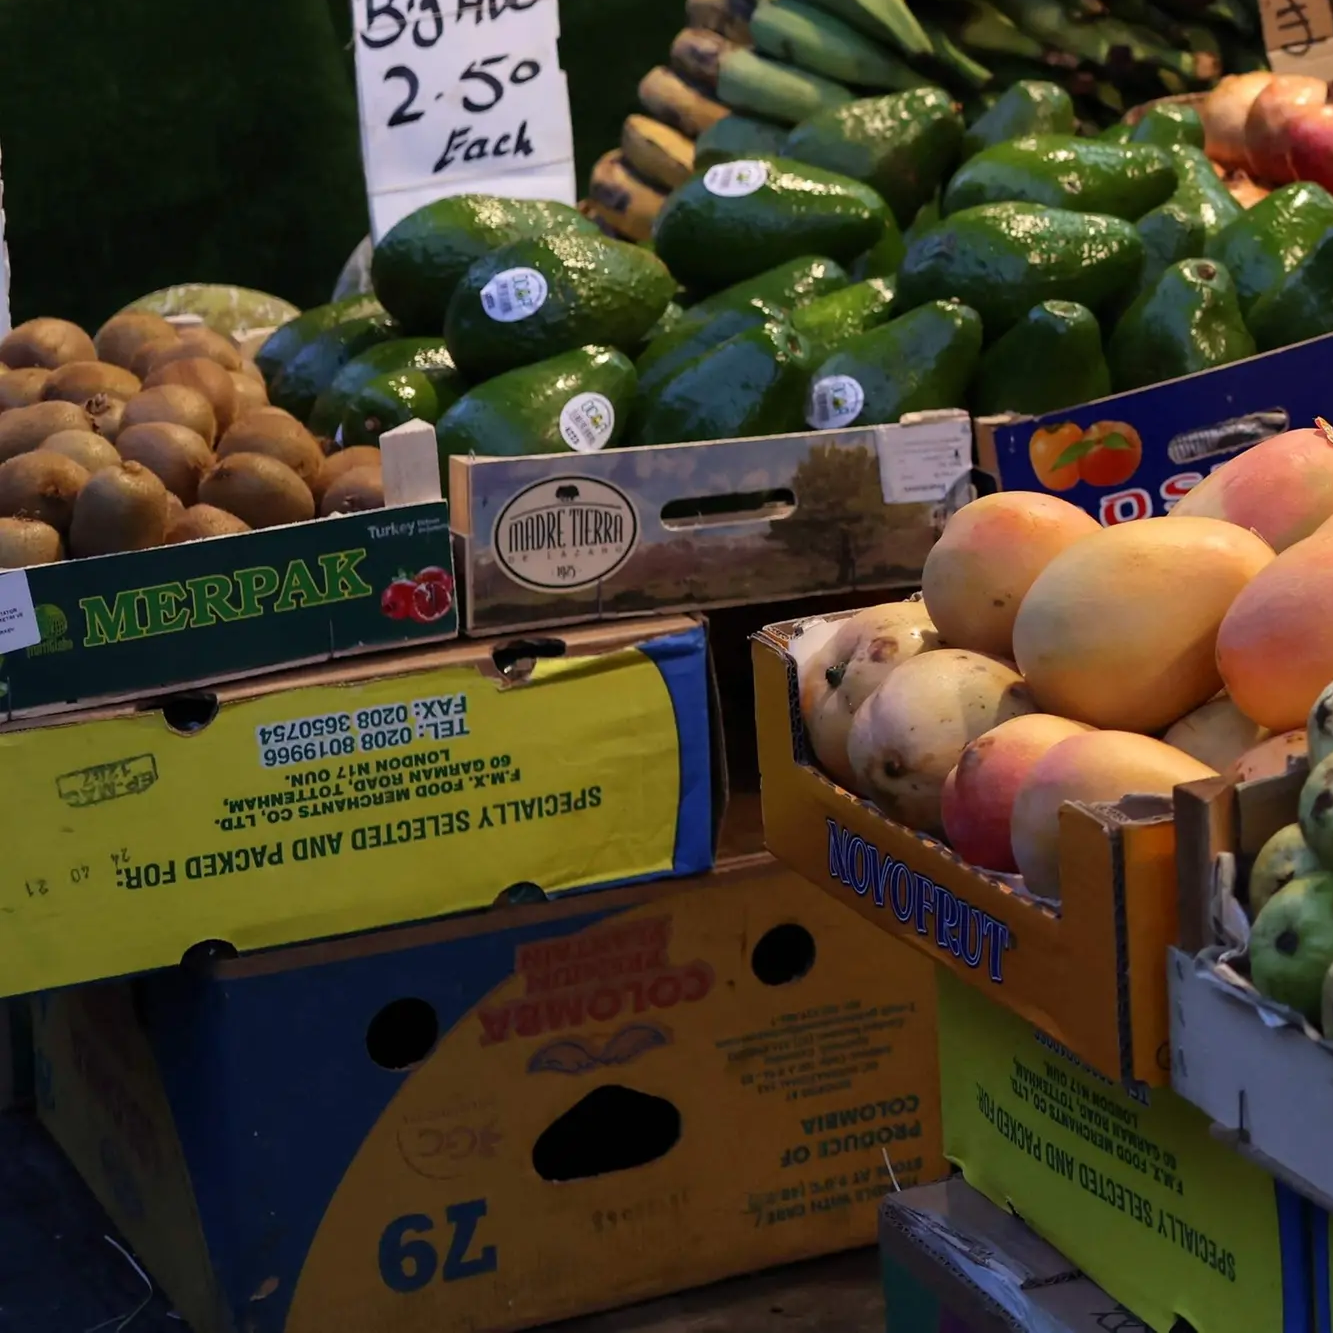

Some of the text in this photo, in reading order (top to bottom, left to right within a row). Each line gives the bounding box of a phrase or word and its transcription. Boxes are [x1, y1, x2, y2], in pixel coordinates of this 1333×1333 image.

[432, 120, 534, 174] Each
[367, 520, 415, 539] Turkey
[508, 507, 624, 554] MADRE TIERRA
[80, 548, 373, 648] MERPAK
[259, 695, 468, 746] FAX: 0208 3650754
[264, 717, 470, 767] TEL: 0208 8019966
[223, 754, 512, 814] 60 GARMAN ROAD, TOTTENHAM,
[336, 761, 372, 781] N17
[375, 748, 450, 773] LONDON
[469, 767, 521, 789] F.M.X.
[298, 784, 410, 819] MERCHANTS
[417, 778, 464, 798] FOOD
[115, 785, 602, 889] SPECIALLY SELECTED AND PACKED FOR:
[214, 813, 256, 831] LTD.
[825, 817, 1009, 984] NOVOFRUT
[800, 1095, 921, 1137] COLOMBIA
[995, 1106, 1043, 1161] PACKED
[1048, 1105, 1114, 1156] MERCHANTS
[780, 1121, 922, 1168] PRODUCE OF
[1044, 1142, 1074, 1181] AND
[1115, 1145, 1147, 1175] FOOD
[1079, 1162, 1153, 1229] SELECTED
[378, 1198, 497, 1294] 79
[1157, 1208, 1236, 1283] SPECIALLY
